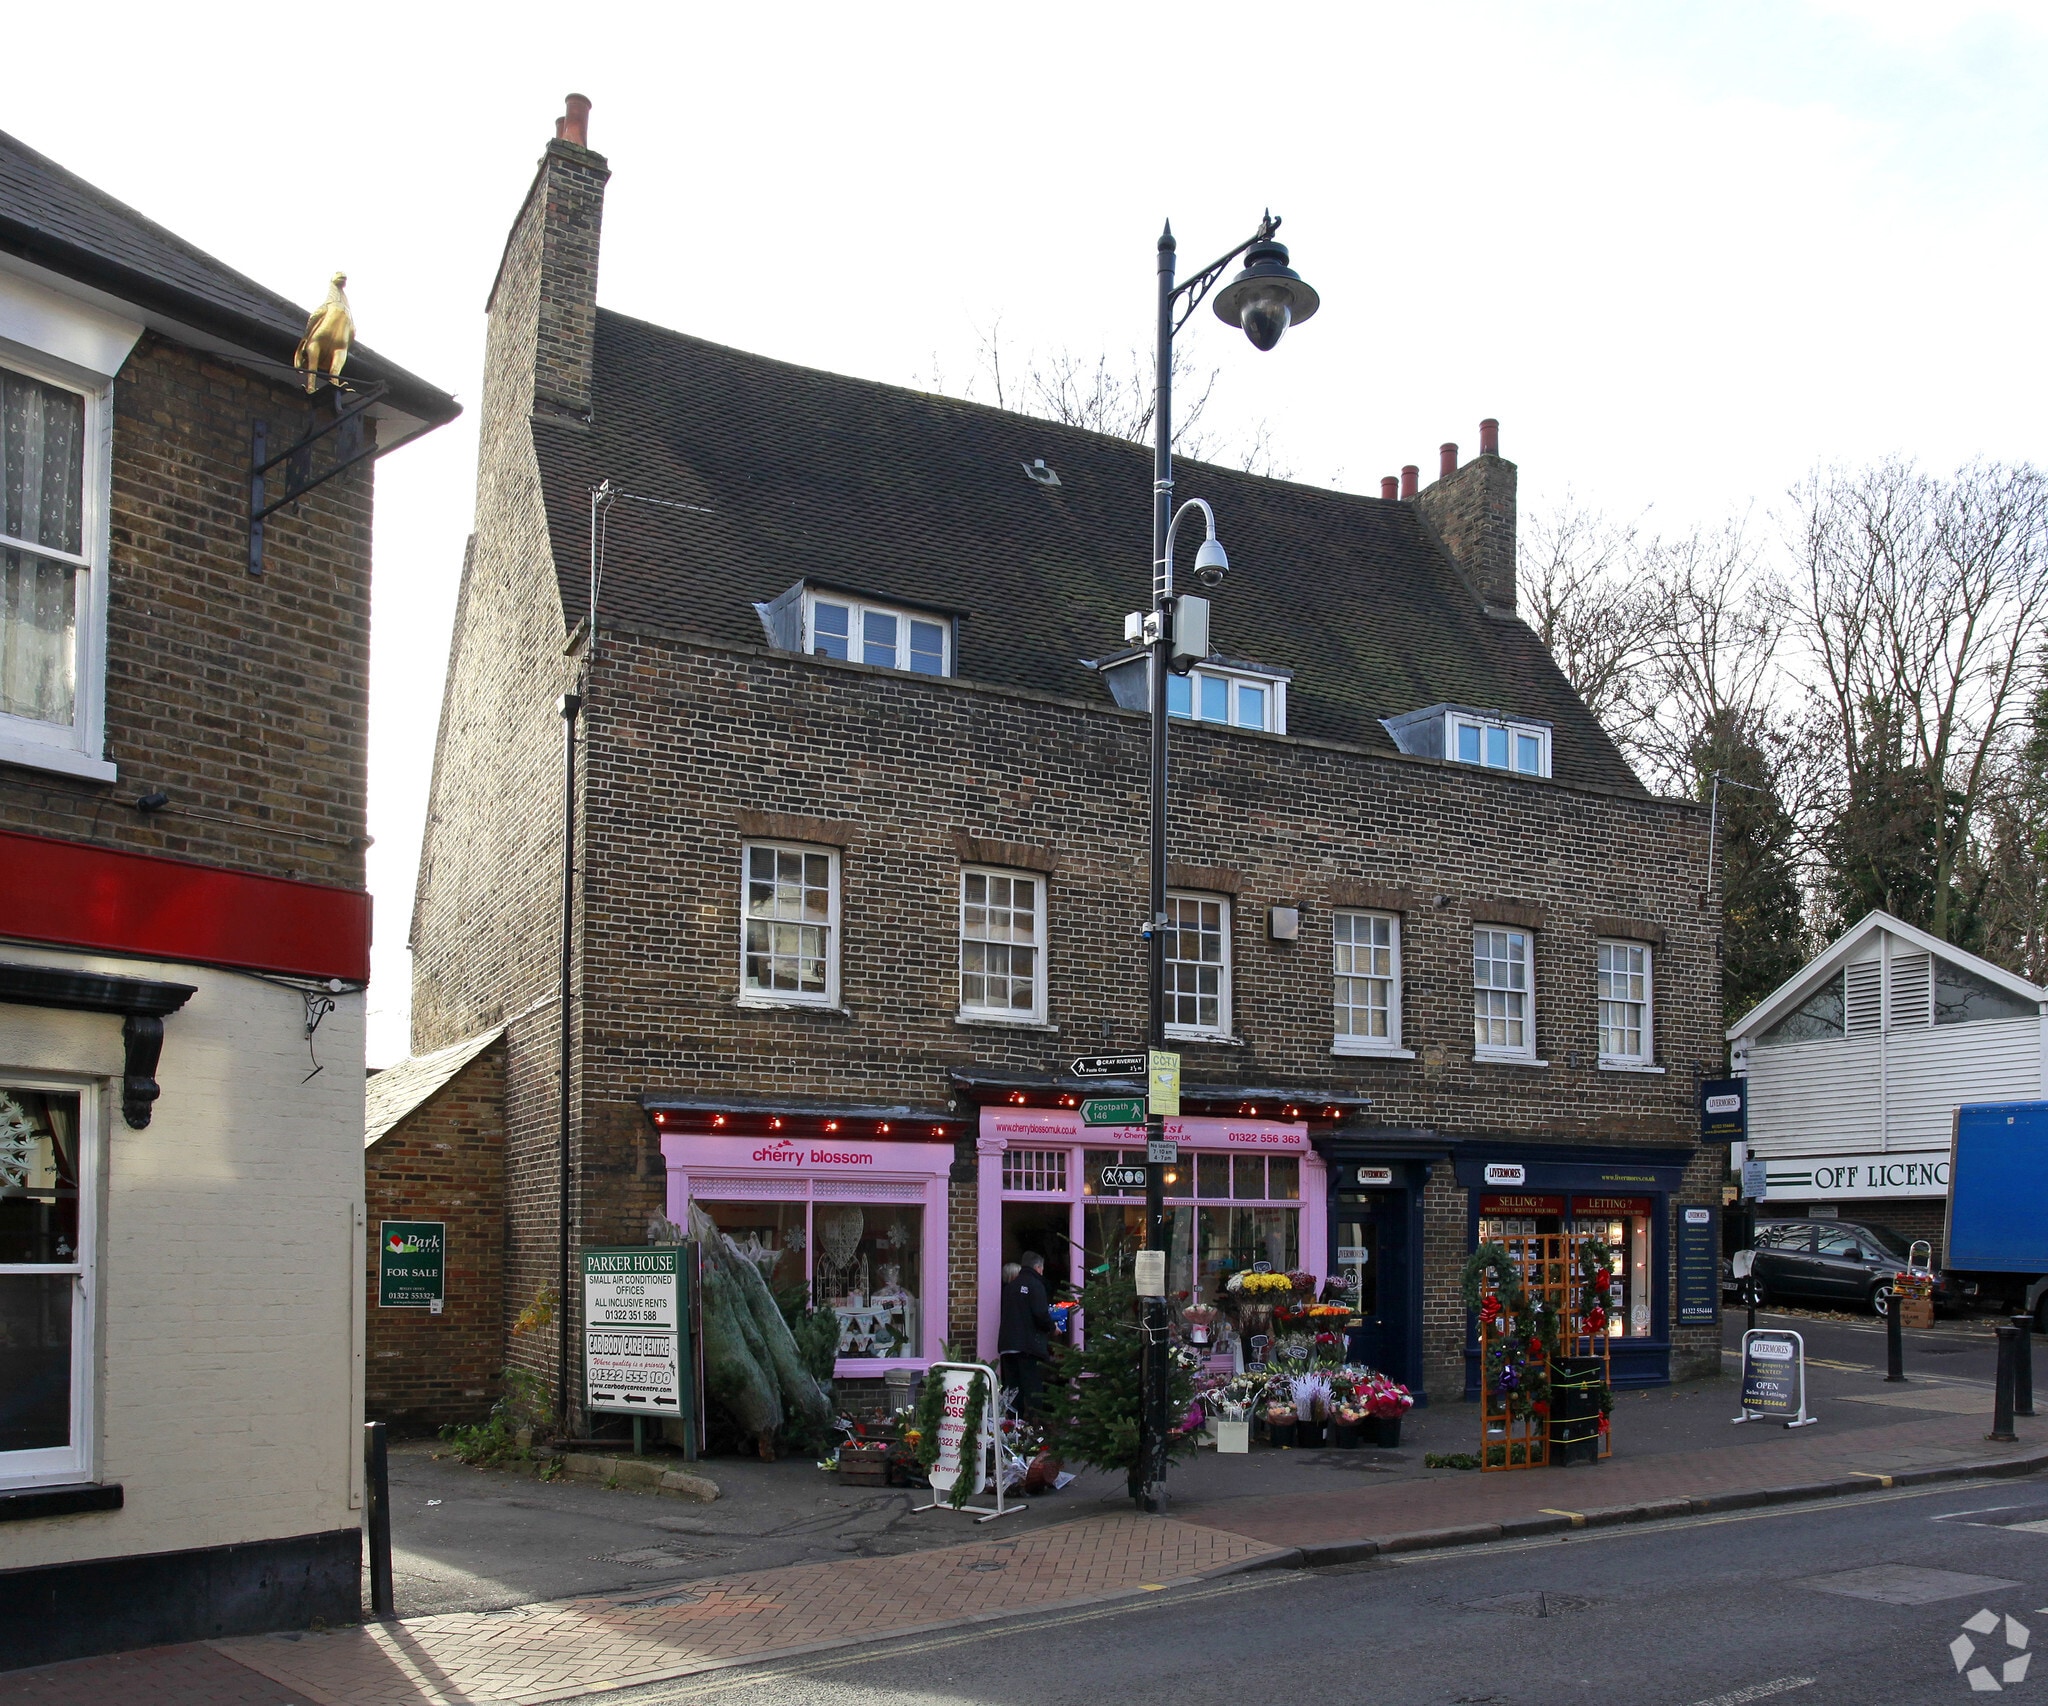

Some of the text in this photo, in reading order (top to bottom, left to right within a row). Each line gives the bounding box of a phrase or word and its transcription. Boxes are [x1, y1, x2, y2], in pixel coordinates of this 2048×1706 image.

[1153, 1055, 1178, 1067] CCTV
[1094, 1103, 1128, 1113] Footpath
[1094, 1112, 1107, 1120] 146
[996, 1123, 1077, 1135] www.cherryblossomuk.co.uk
[1124, 1132, 1148, 1140] Cherry
[1228, 1132, 1300, 1144] 01322 556 363
[752, 1148, 872, 1166] cherry blossom
[1490, 1168, 1521, 1178] LIVERMORES
[1815, 1166, 1858, 1188] OFF
[1500, 1196, 1537, 1207] SELLING
[1589, 1199, 1626, 1208] LETTING
[1157, 1215, 1162, 1224] 7
[408, 1234, 440, 1248] Park
[587, 1256, 674, 1272] PARKER HOUSE
[386, 1268, 438, 1277] FOR SALE
[589, 1276, 672, 1284] SMALL AIR CONDITIONED
[616, 1286, 644, 1294] OFFICES
[595, 1298, 667, 1308] ALL INCLUSIVE RENTS
[606, 1310, 656, 1320] 01322 351 588
[589, 1334, 669, 1357] CAR BODY CARE CENTRE
[1754, 1344, 1788, 1354] LIVERMORES
[612, 1360, 631, 1368] quality
[644, 1362, 666, 1370] priority
[589, 1368, 671, 1384] 01322 555 100
[589, 1383, 672, 1392] www.carbodycarecentre.com
[1756, 1381, 1779, 1390] OPEN
[944, 1394, 970, 1405] herry
[1766, 1391, 1787, 1399] Lettings
